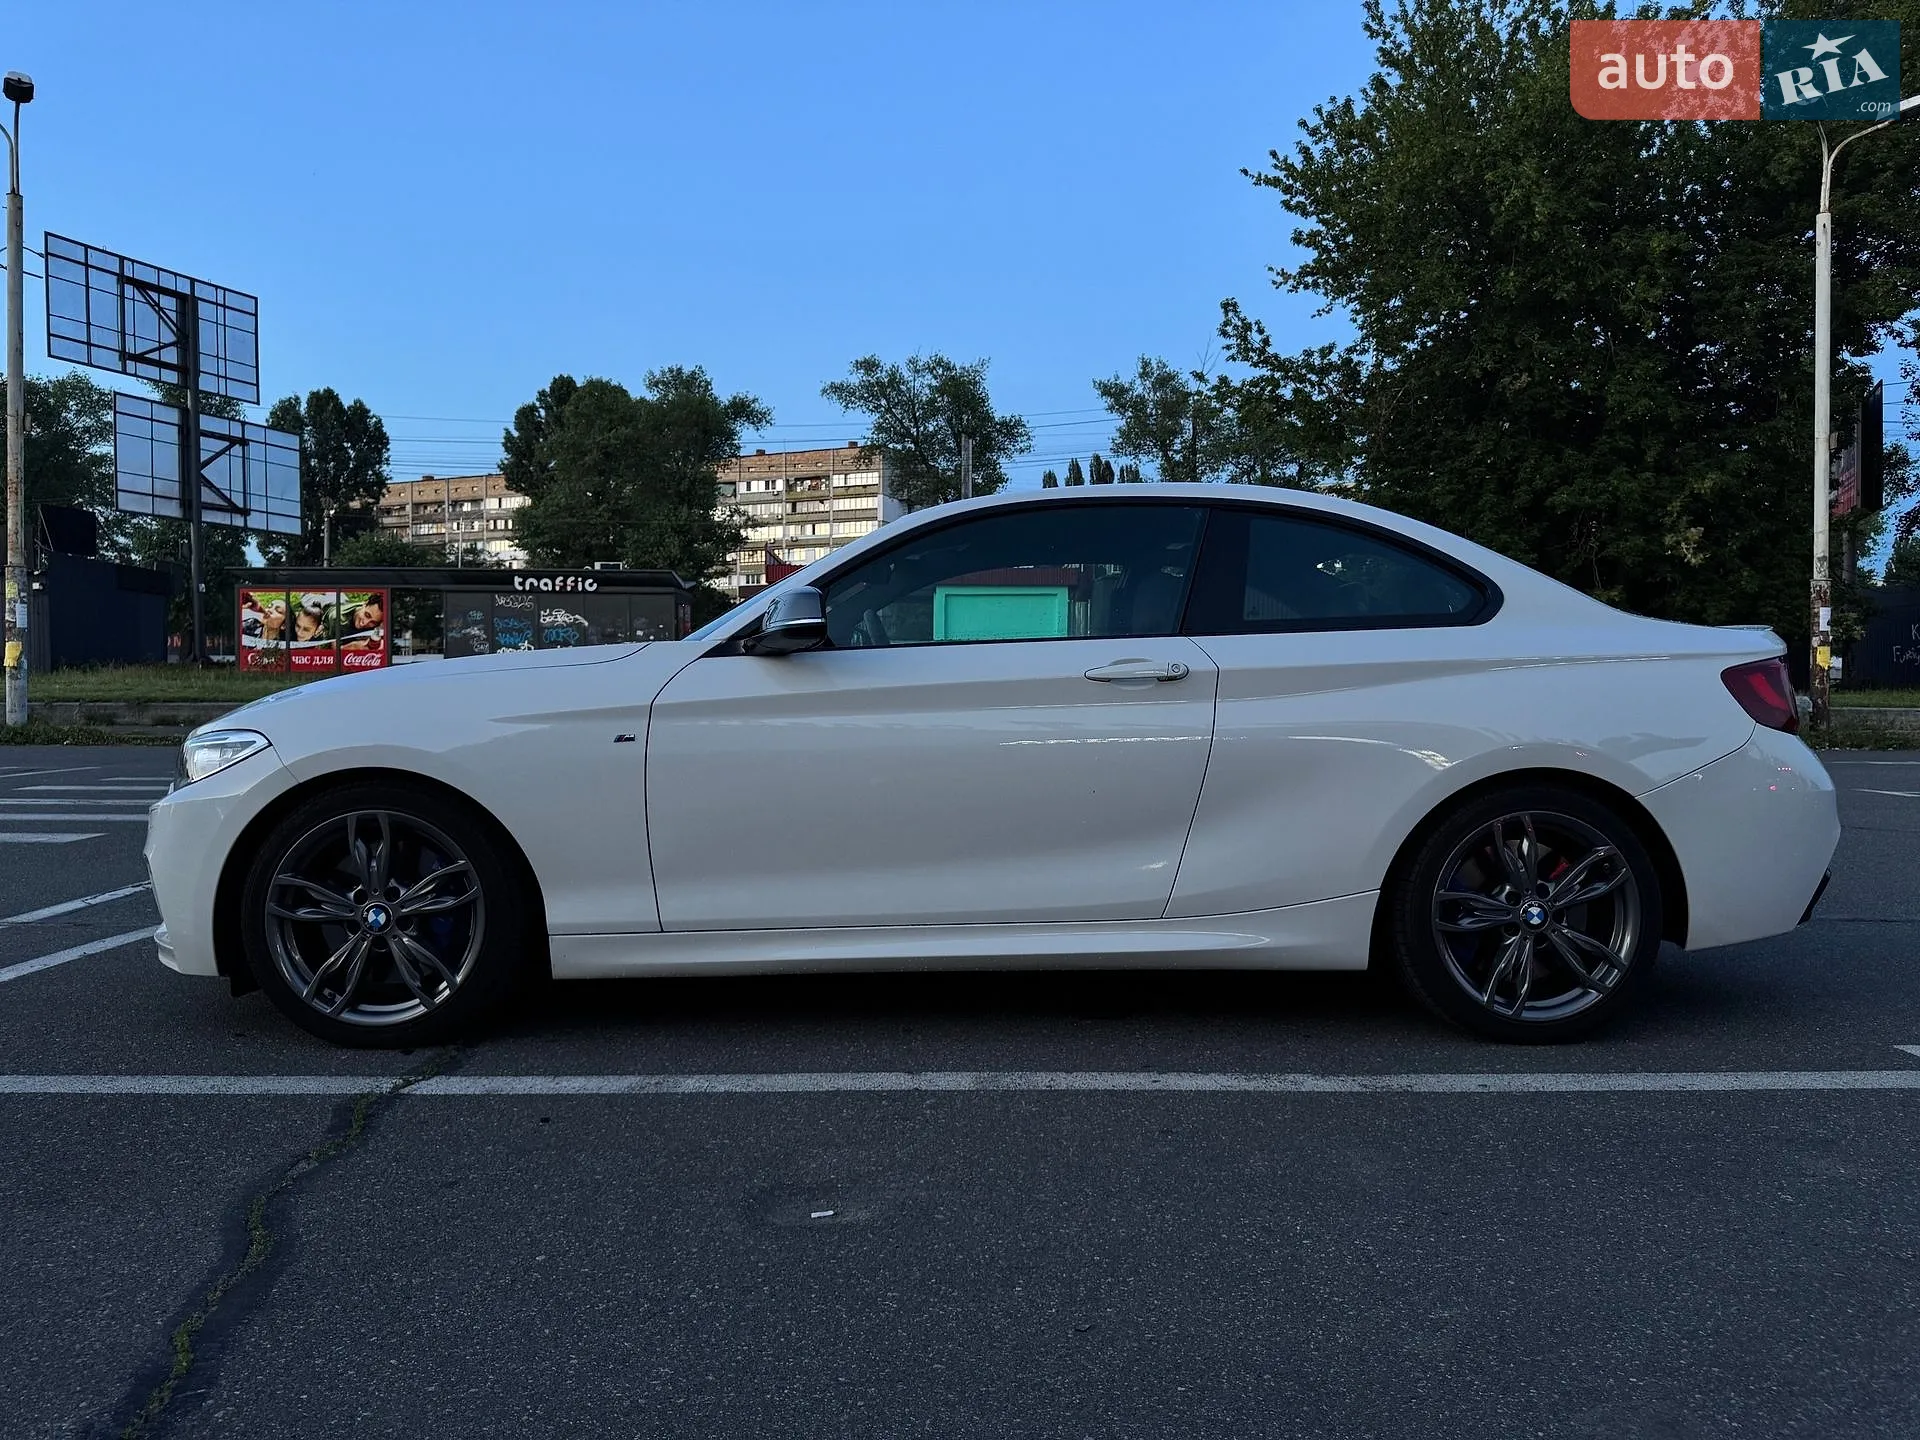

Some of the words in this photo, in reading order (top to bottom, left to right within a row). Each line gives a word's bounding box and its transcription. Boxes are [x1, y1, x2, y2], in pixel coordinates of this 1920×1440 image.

[514, 575, 597, 591] traffic
[292, 655, 310, 664] час
[312, 655, 334, 665] для
